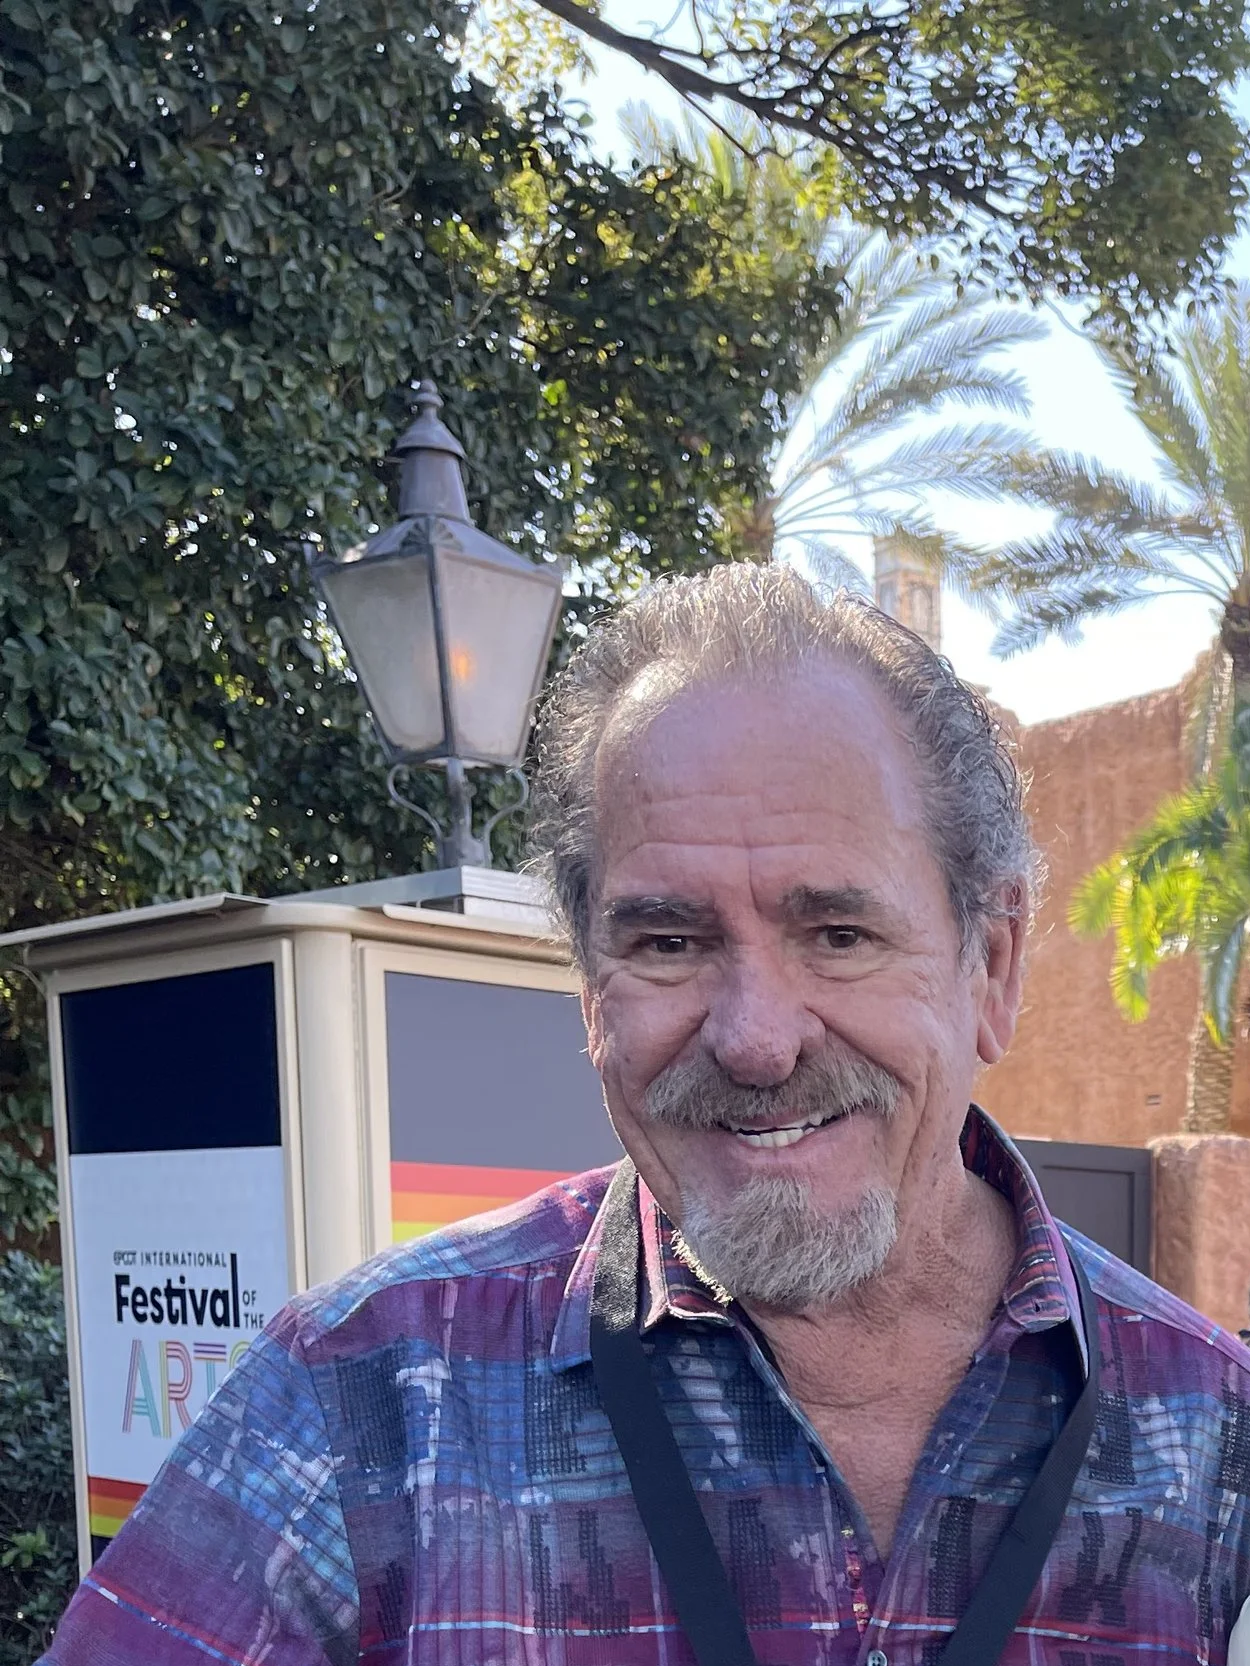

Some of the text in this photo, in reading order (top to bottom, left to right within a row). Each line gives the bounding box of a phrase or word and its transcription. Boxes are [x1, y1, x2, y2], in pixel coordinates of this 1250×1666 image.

[140, 1252, 227, 1267] INTERNATIONAL
[114, 1252, 241, 1328] Festival
[242, 1290, 256, 1305] OF
[244, 1313, 264, 1329] THE
[122, 1338, 254, 1440] ART
